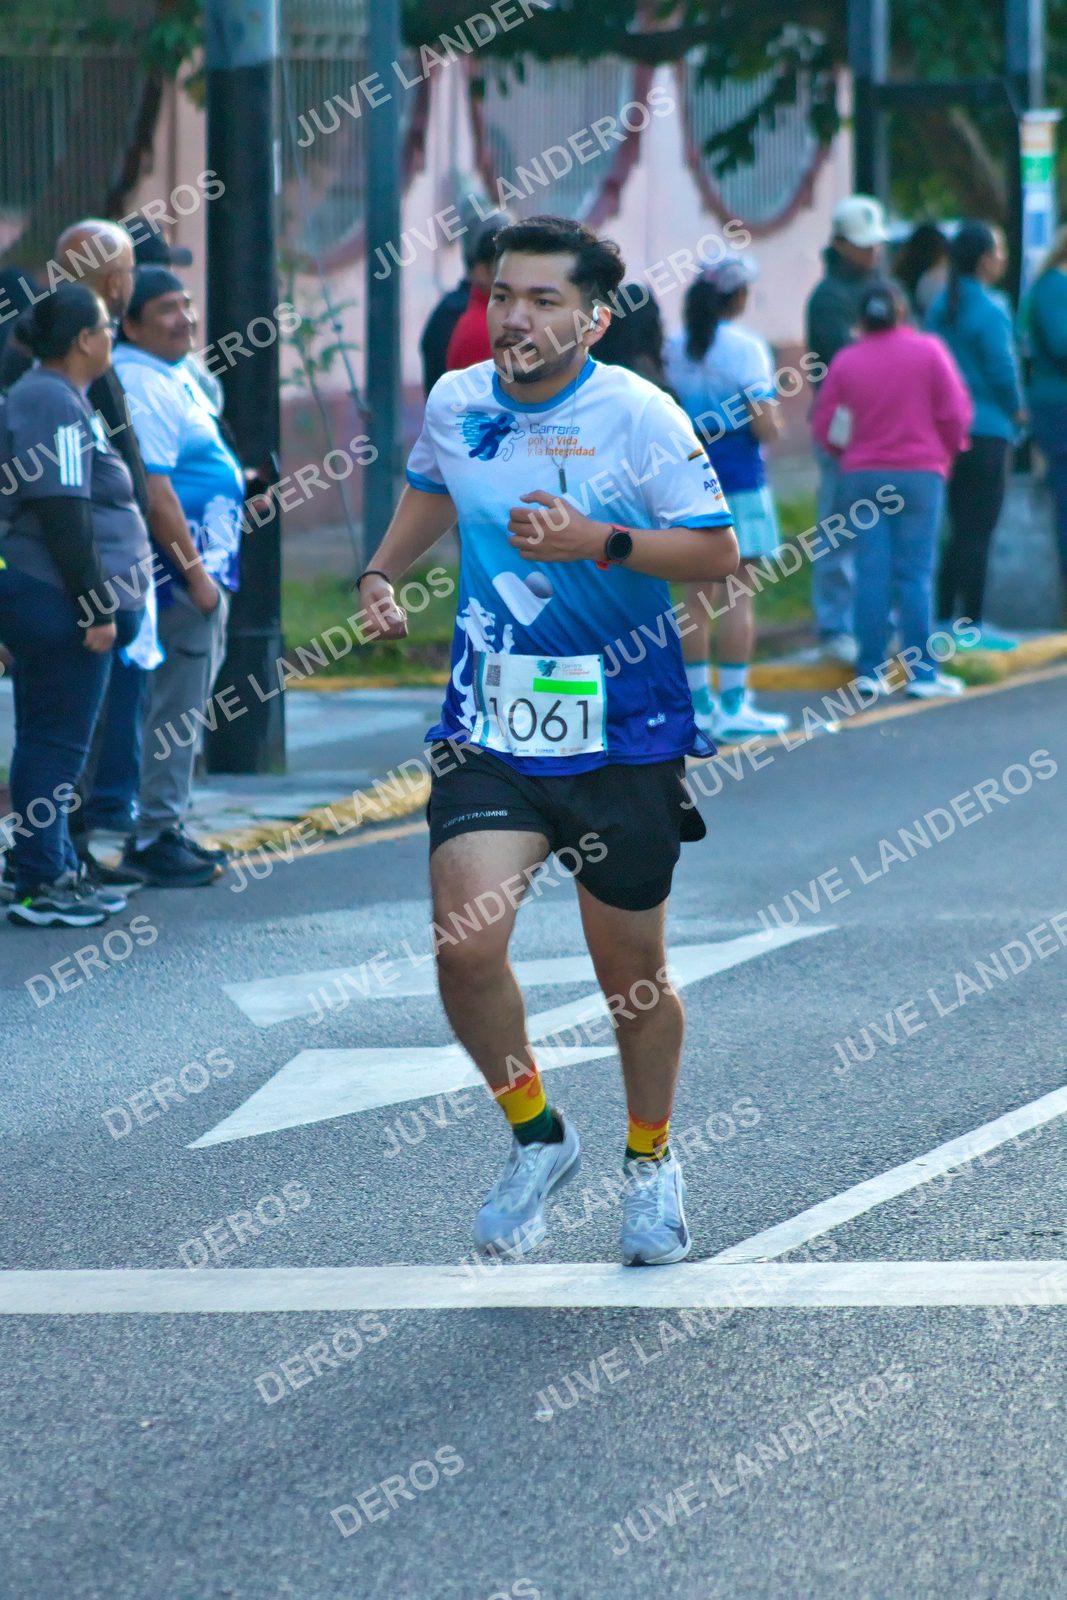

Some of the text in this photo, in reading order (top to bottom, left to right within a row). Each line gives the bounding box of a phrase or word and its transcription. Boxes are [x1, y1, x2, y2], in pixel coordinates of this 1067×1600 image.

[529, 423, 580, 435] Carrera
[556, 436, 578, 446] Vida
[545, 447, 595, 457] Integridad
[489, 697, 589, 742] 1061
